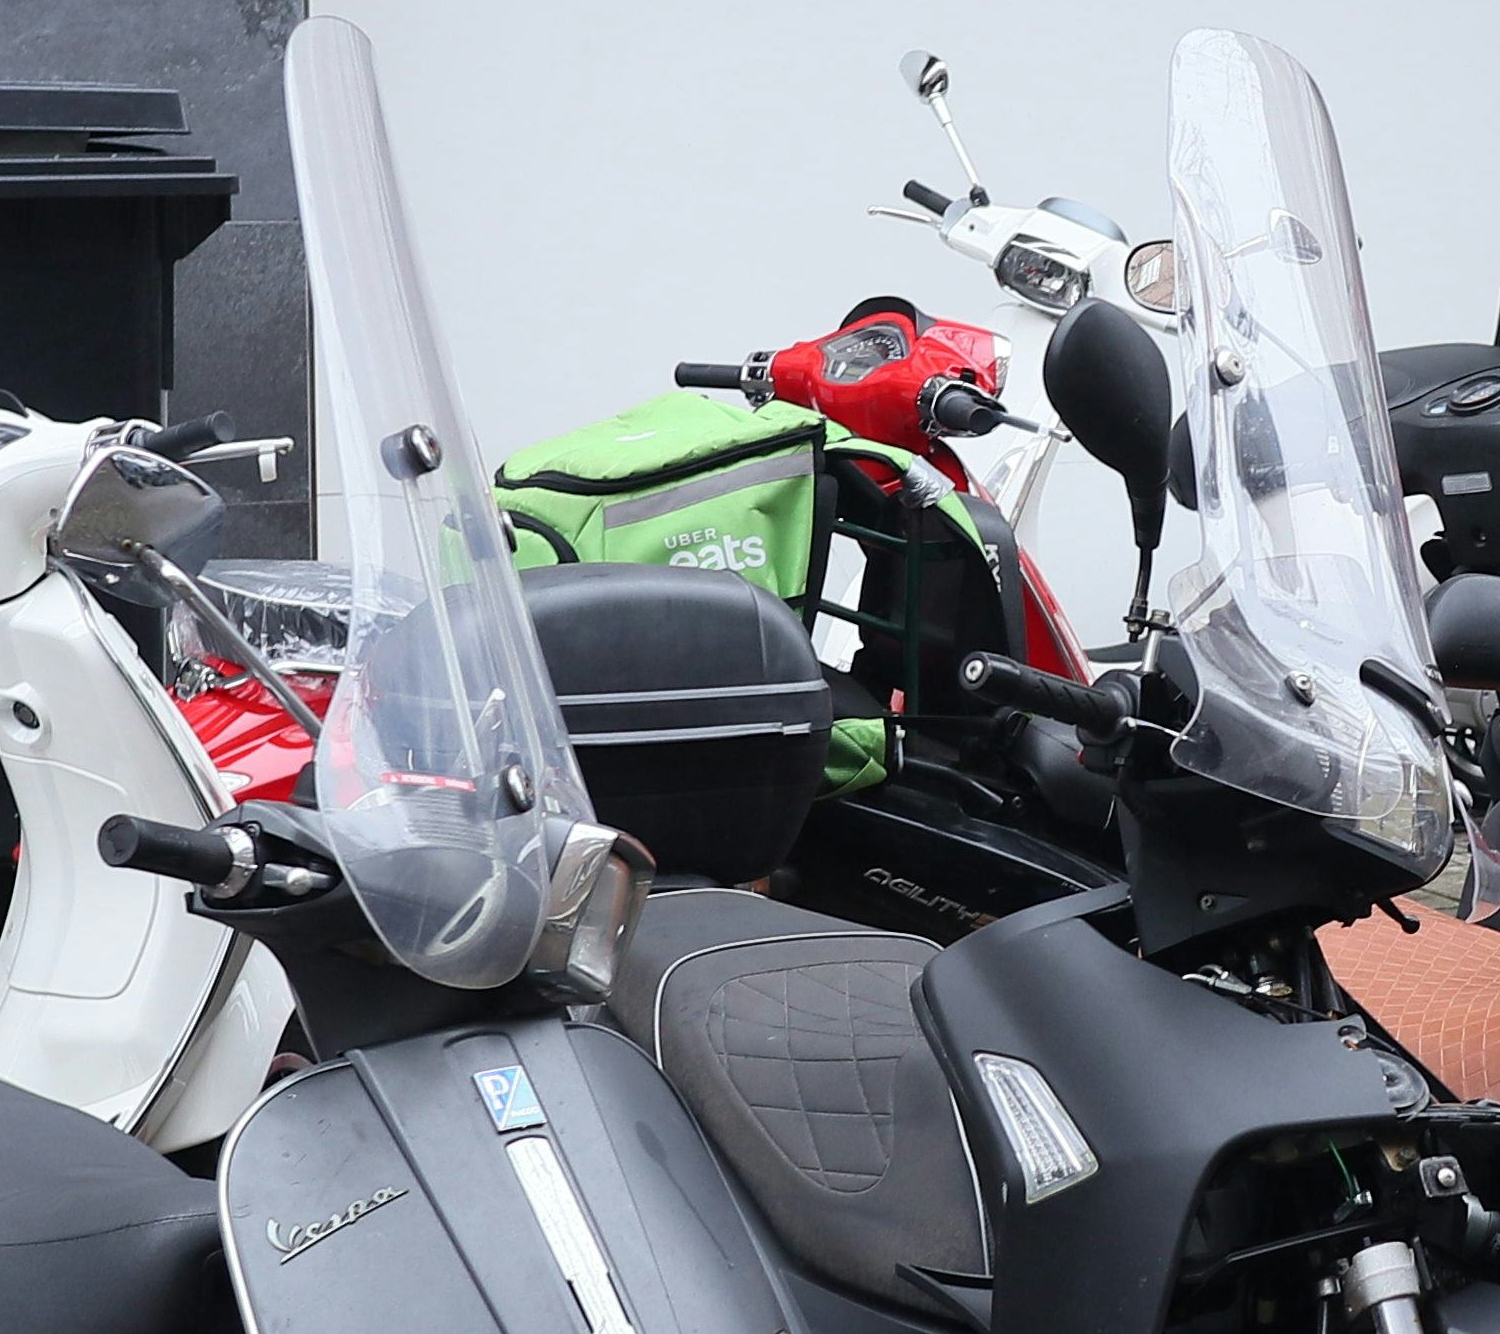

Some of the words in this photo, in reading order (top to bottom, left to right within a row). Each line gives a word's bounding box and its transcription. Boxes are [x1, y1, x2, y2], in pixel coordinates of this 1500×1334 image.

[663, 527, 718, 549] UBER
[668, 533, 767, 572] eats
[863, 867, 981, 921] AGILITY
[266, 1187, 410, 1266] Vespa
